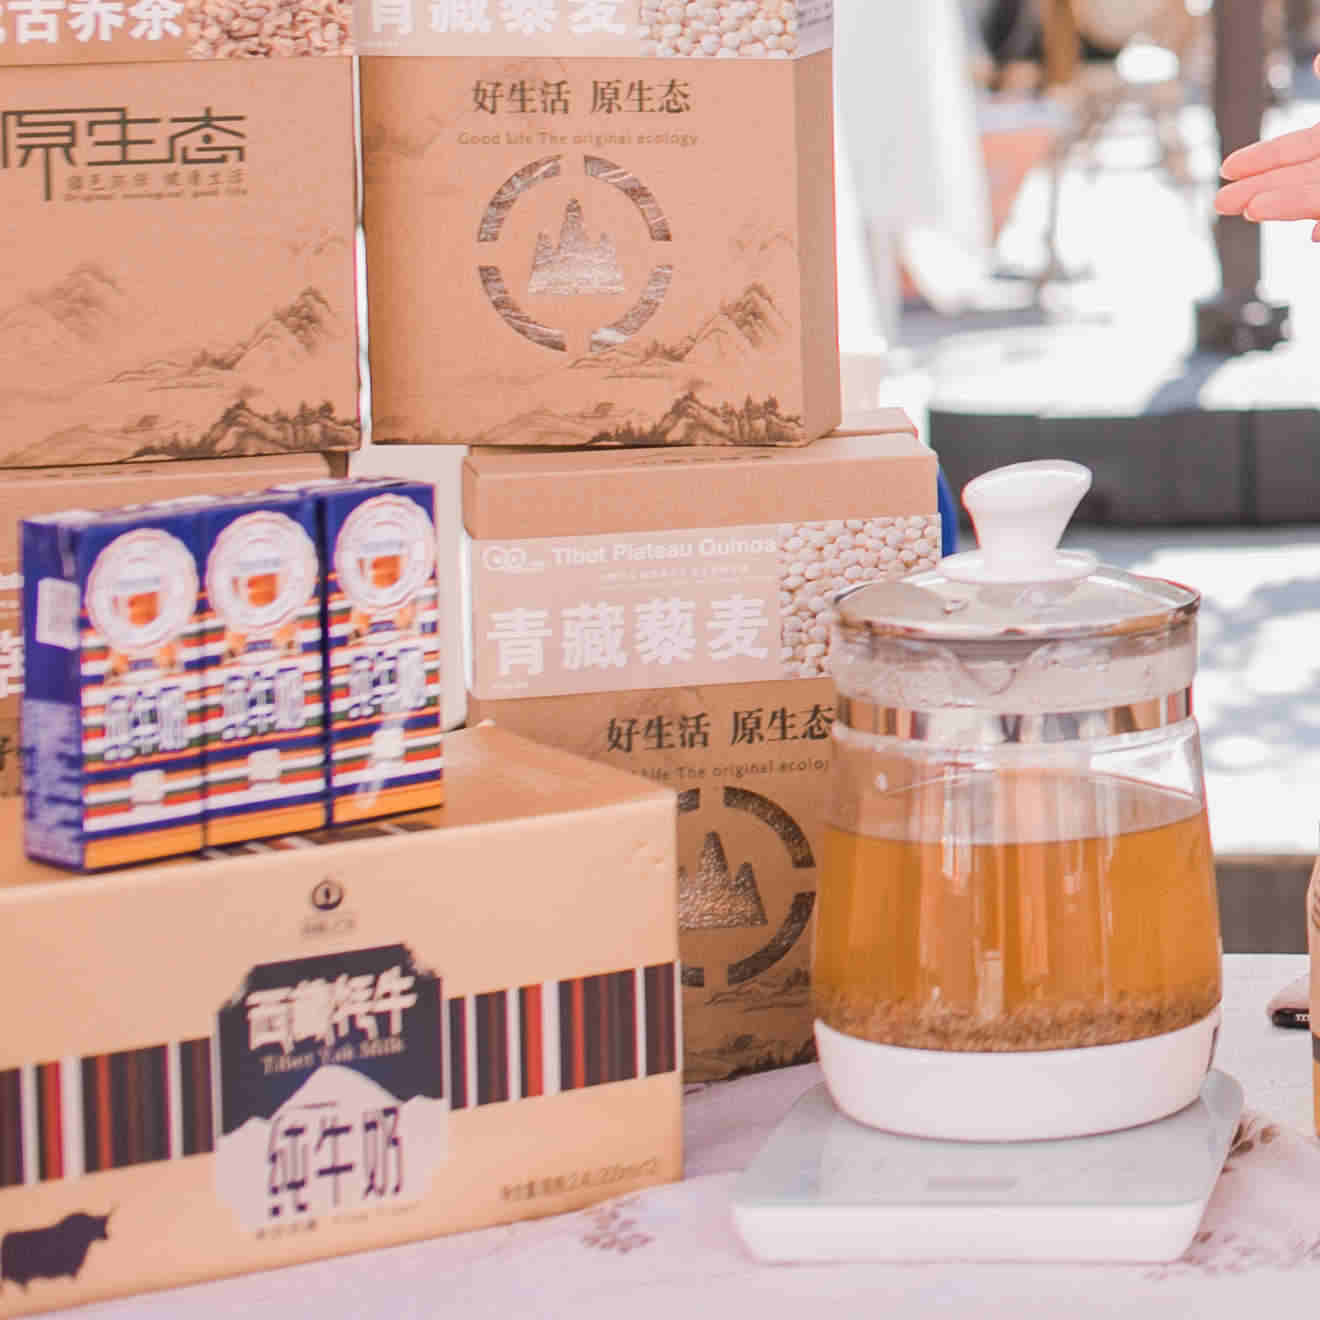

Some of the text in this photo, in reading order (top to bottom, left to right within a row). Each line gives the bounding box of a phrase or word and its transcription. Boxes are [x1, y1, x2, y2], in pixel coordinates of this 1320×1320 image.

[472, 78, 691, 115] 好生活 原生态
[2, 106, 247, 202] 原生态
[457, 131, 500, 145] Good
[540, 131, 568, 145] The
[572, 131, 633, 148] original
[637, 132, 699, 148] ecology
[612, 542, 696, 561] Plateau
[700, 536, 777, 555] Quinoa
[487, 592, 769, 676] 青藏藜麦
[607, 704, 834, 753] 好生活 原生态
[712, 760, 773, 779] original
[267, 1107, 404, 1218] 纯牛奶
